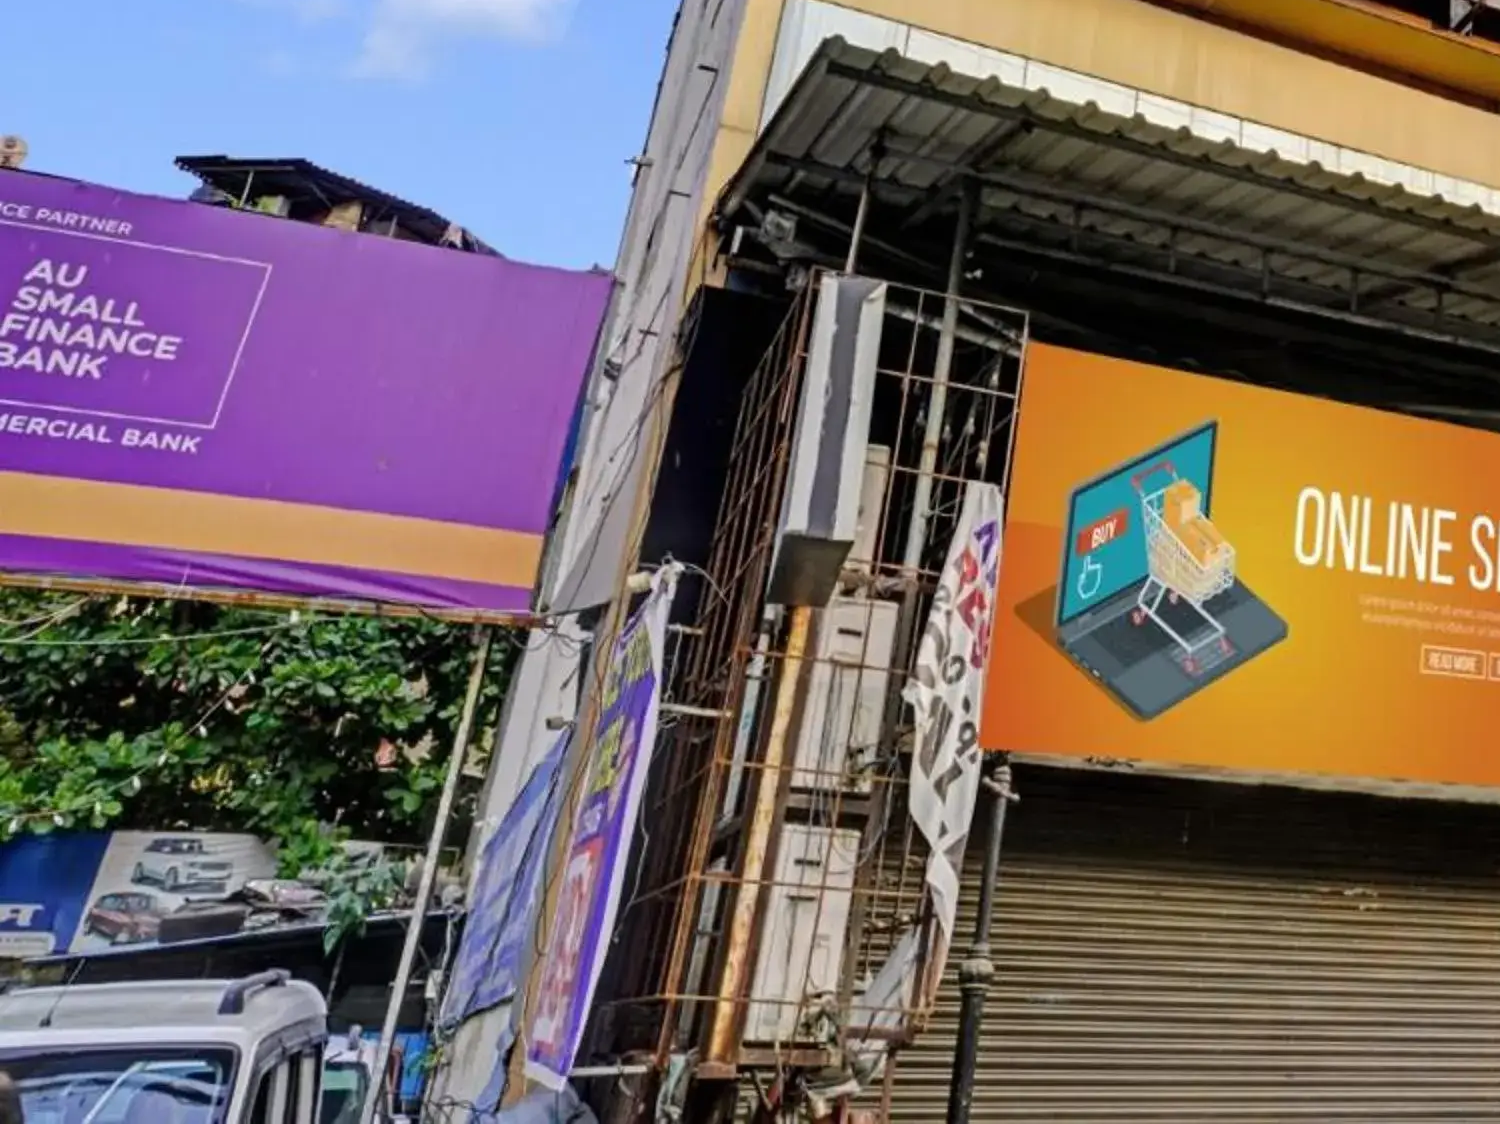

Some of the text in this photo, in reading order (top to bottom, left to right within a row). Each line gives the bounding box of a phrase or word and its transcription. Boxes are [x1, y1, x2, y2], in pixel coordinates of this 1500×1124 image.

[35, 207, 133, 236] PARTNER
[24, 259, 88, 288] AU
[12, 286, 145, 327] SMALL
[0, 312, 183, 361] FINANCE
[0, 342, 107, 380] BANK
[121, 428, 202, 455] BANK
[1091, 518, 1118, 548] BUY
[1294, 486, 1457, 585] ONLINE
